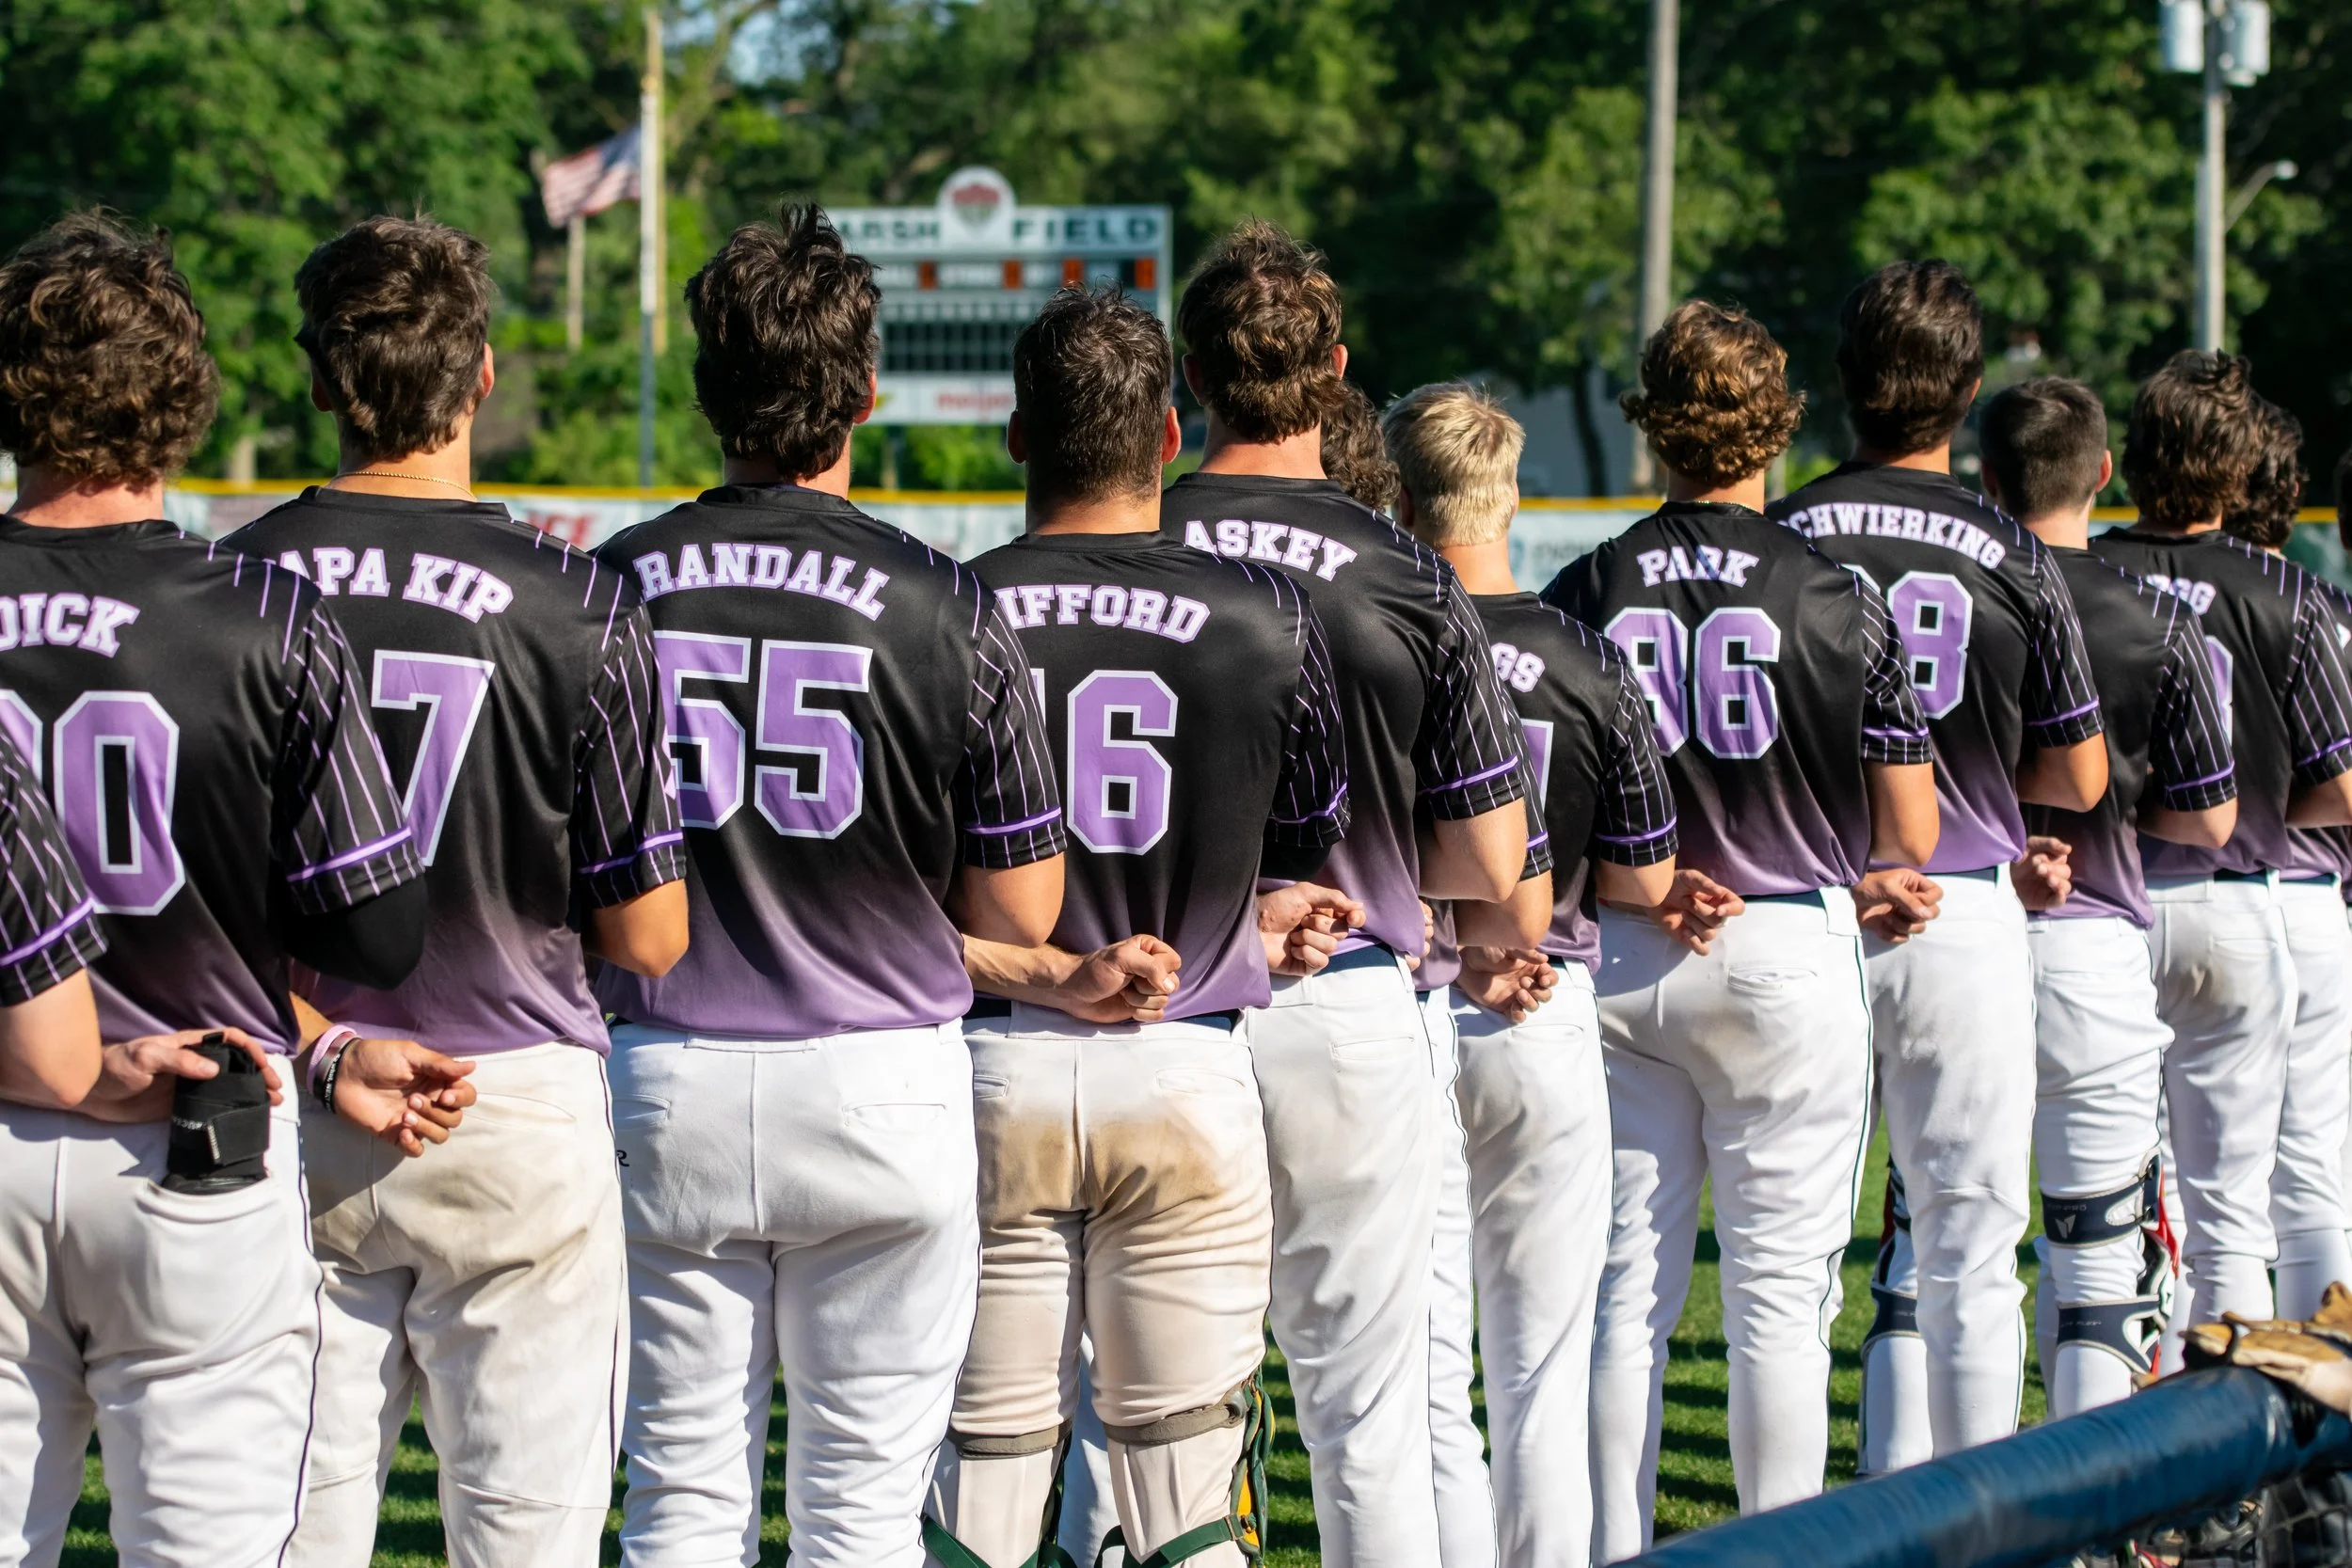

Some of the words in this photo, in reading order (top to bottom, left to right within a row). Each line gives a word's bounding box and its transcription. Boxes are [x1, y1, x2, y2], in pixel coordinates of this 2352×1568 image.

[1013, 218, 1158, 242] FIELD
[1184, 519, 1358, 582] ASKEY
[1636, 545, 1760, 588] PARK
[1776, 502, 2006, 569] CHWIERKING
[403, 553, 514, 624] KIP
[632, 543, 890, 621] RANDALL
[993, 584, 1210, 643] IFFORD
[1490, 642, 1546, 693] GS
[1841, 563, 1973, 720] 8
[372, 649, 495, 866] 7
[653, 630, 873, 840] 55
[1030, 668, 1178, 856] 6
[0, 689, 186, 916] 0
